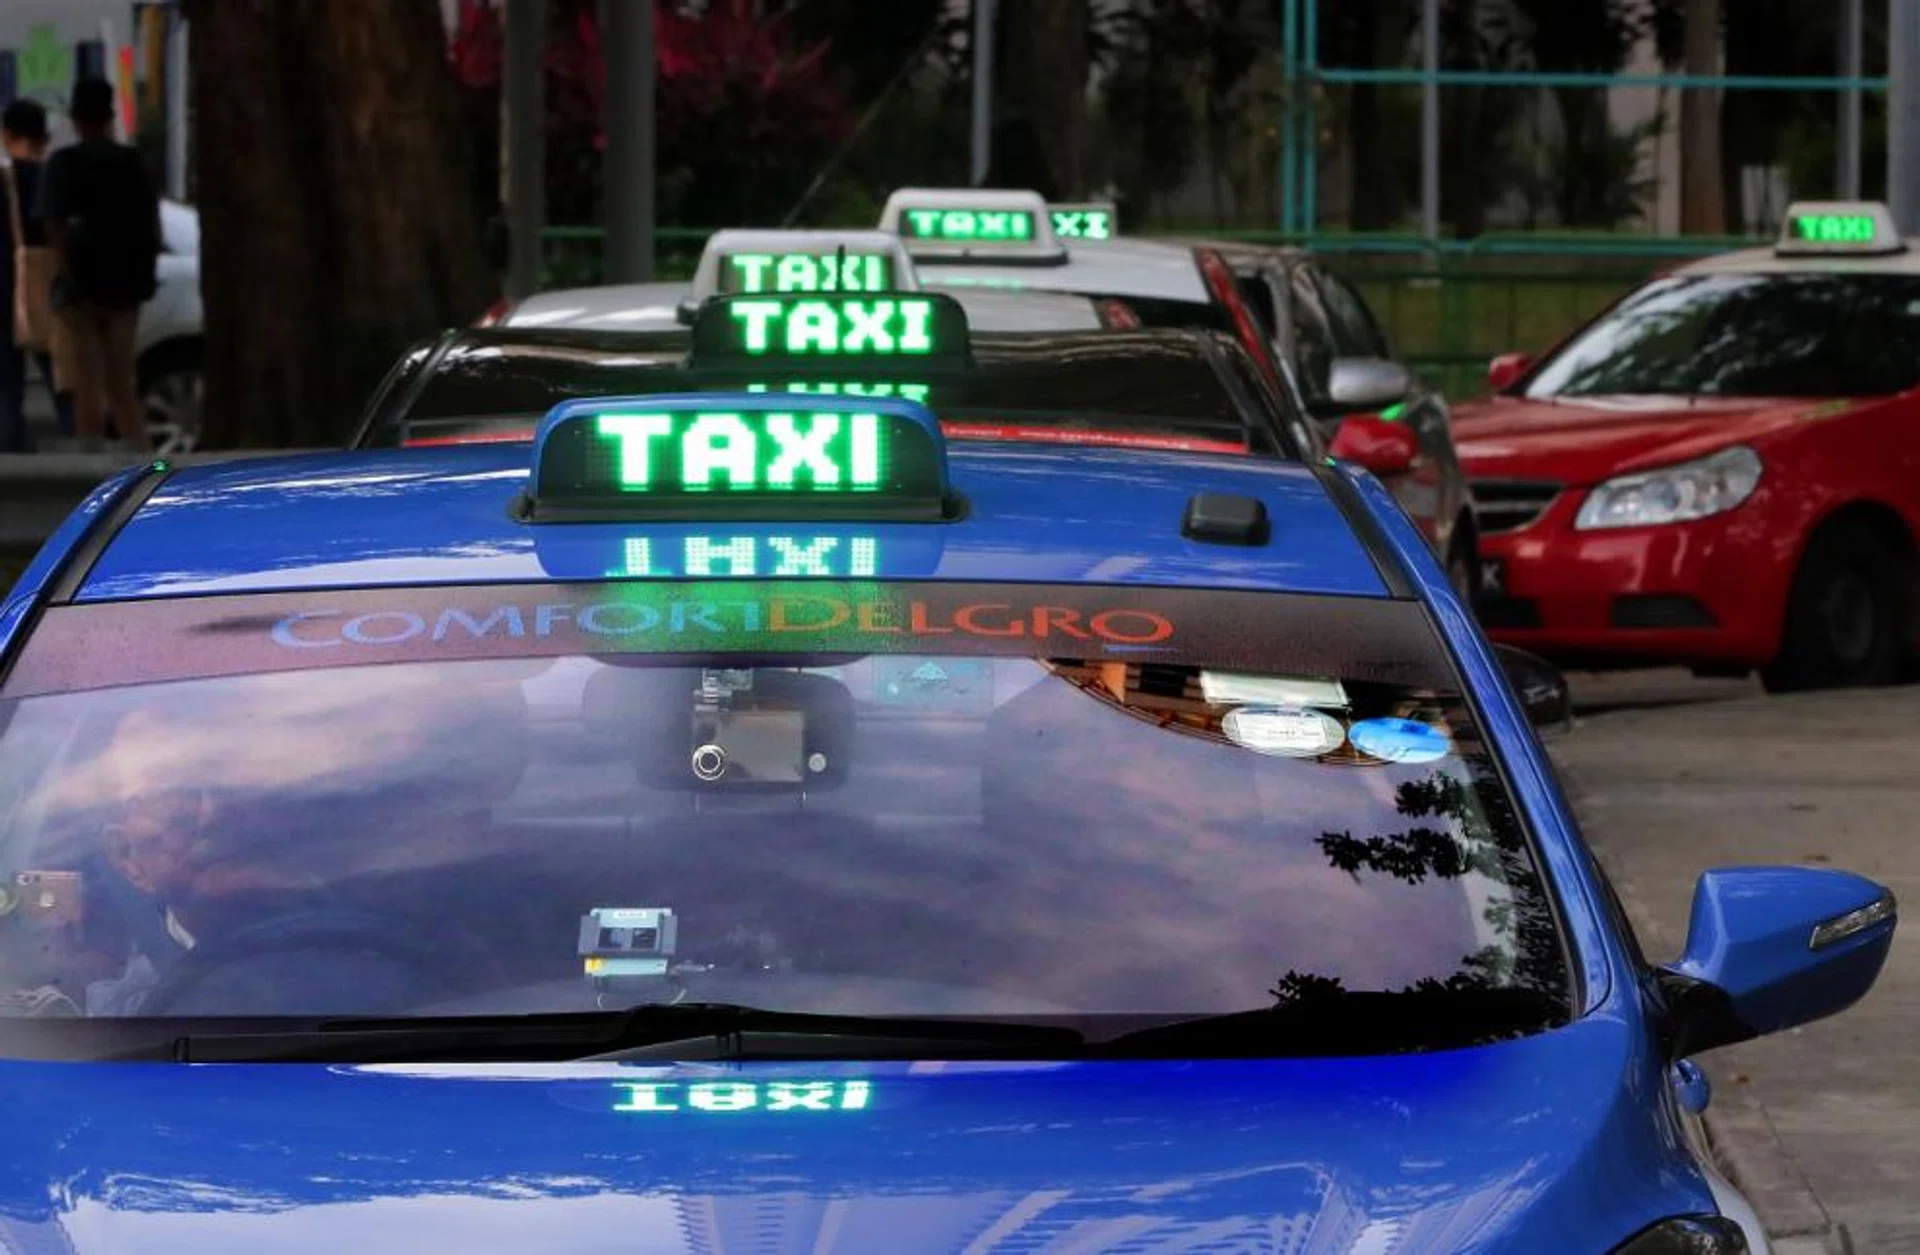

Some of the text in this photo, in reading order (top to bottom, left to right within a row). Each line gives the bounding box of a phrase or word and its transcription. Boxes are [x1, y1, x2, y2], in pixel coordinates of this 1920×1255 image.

[908, 210, 1028, 239] TAXI
[1053, 211, 1109, 239] XI
[1798, 215, 1872, 241] TAXI
[732, 254, 882, 292] TAXI
[731, 301, 931, 353] TAXI
[597, 413, 879, 491] TAXI
